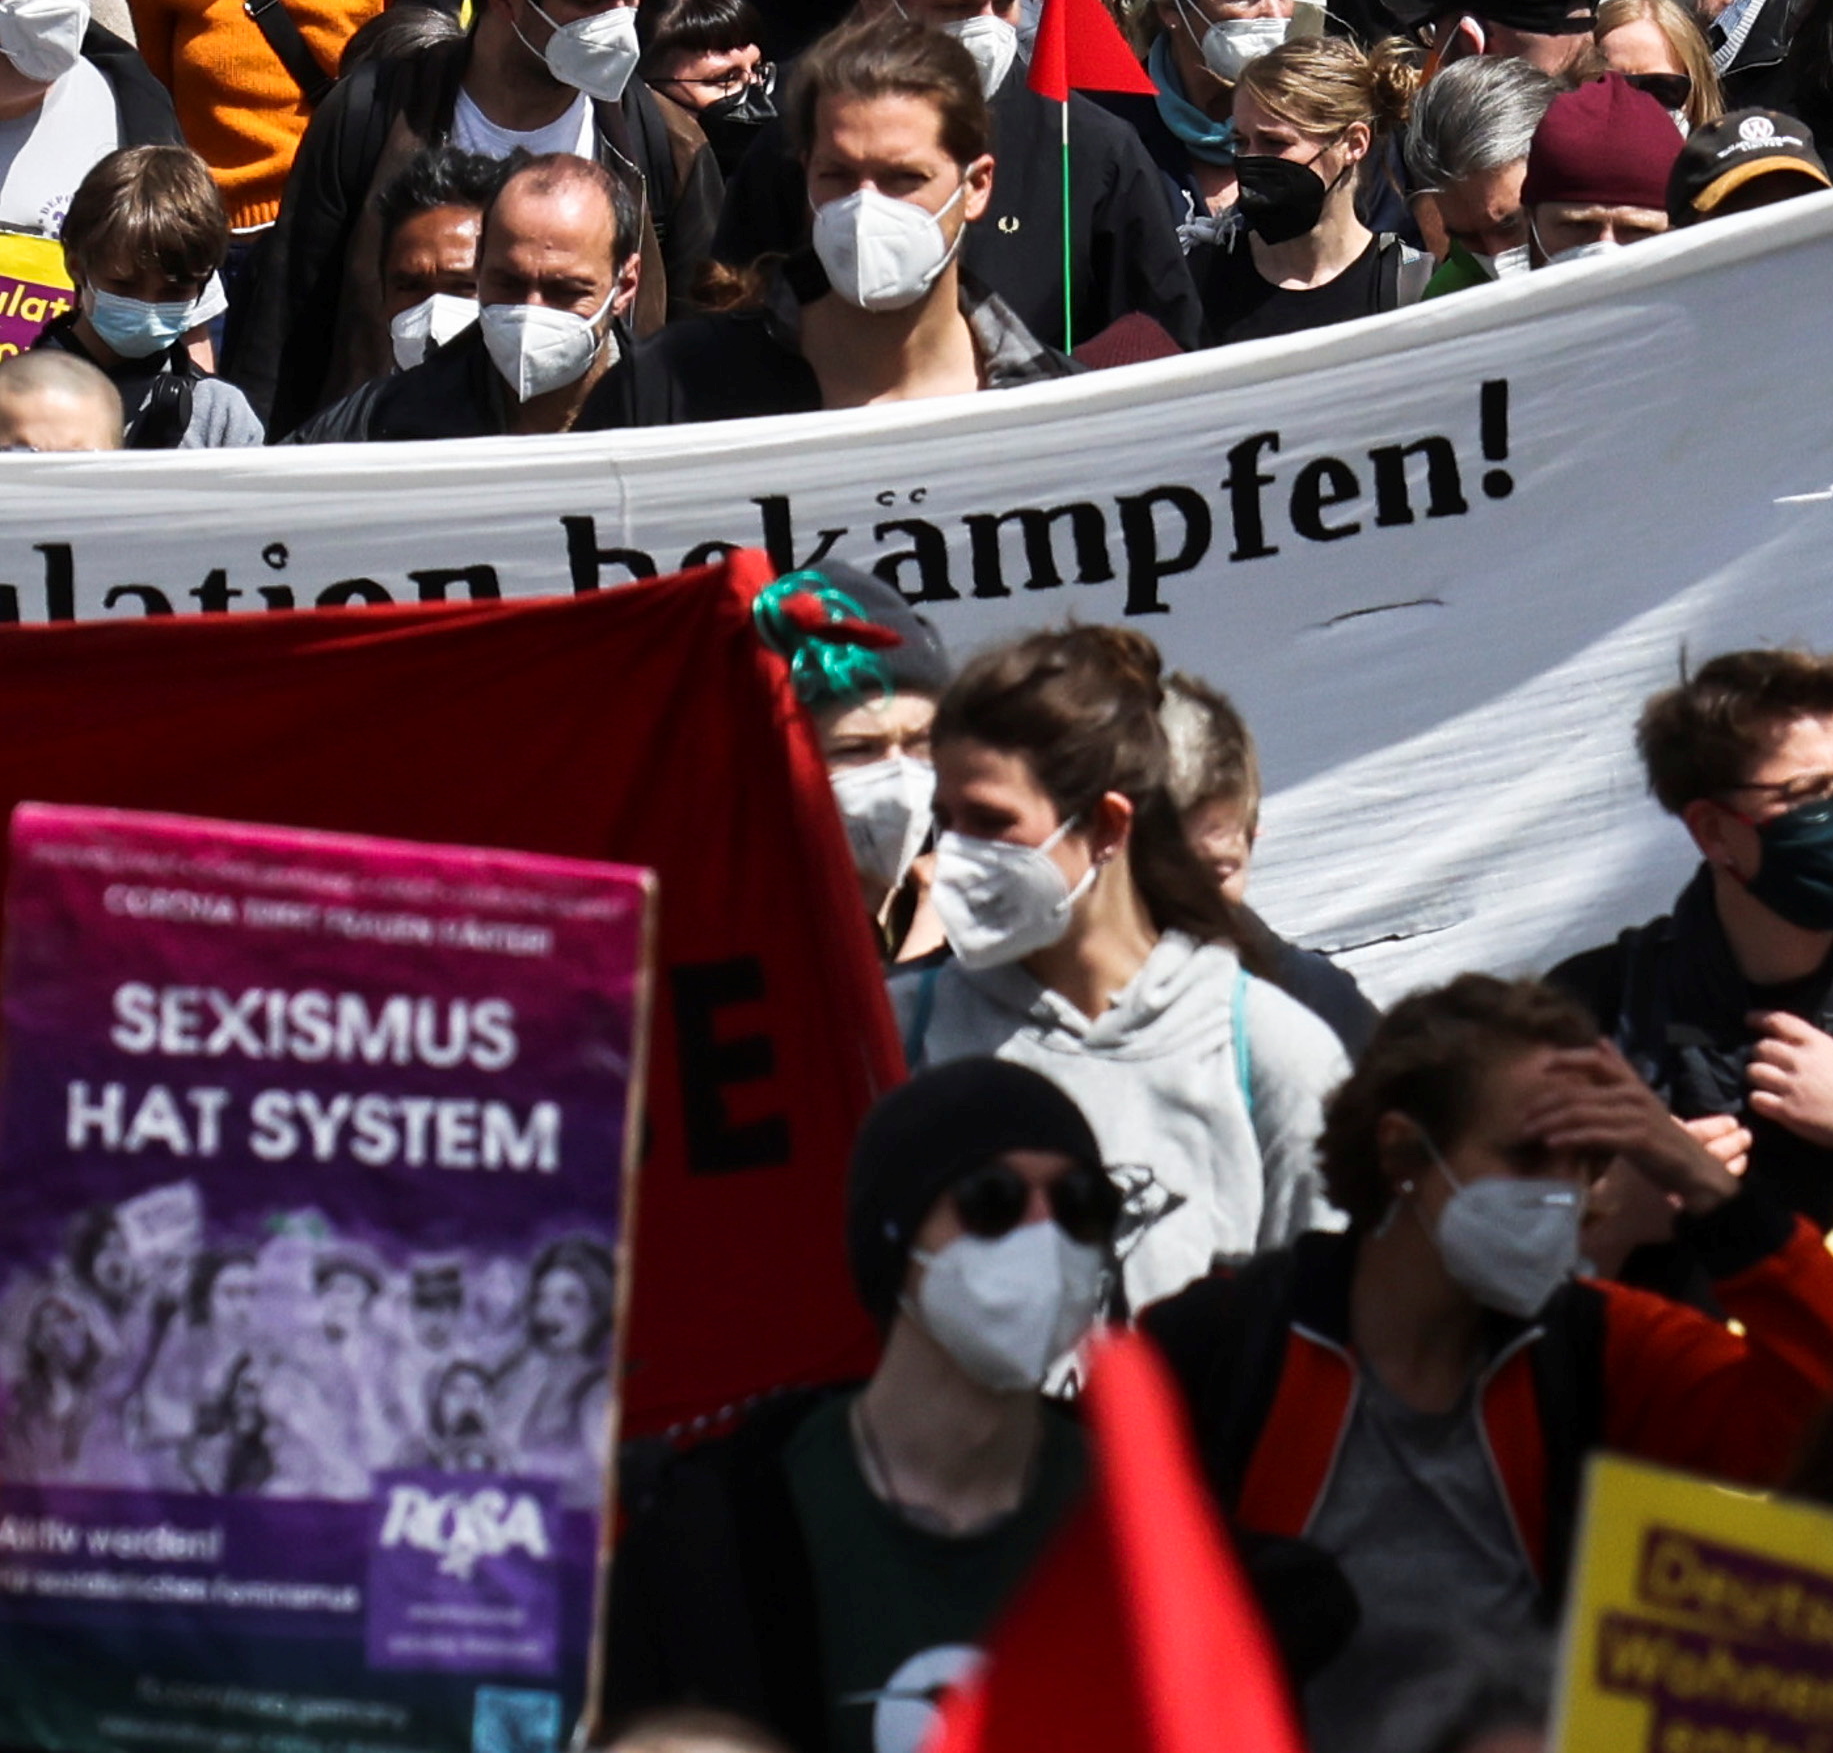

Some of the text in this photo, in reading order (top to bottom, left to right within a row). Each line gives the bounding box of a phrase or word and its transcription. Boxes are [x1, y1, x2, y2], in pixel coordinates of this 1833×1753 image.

[111, 983, 518, 1068] SEXISMUS
[67, 1083, 561, 1173] HAT SYSTEM
